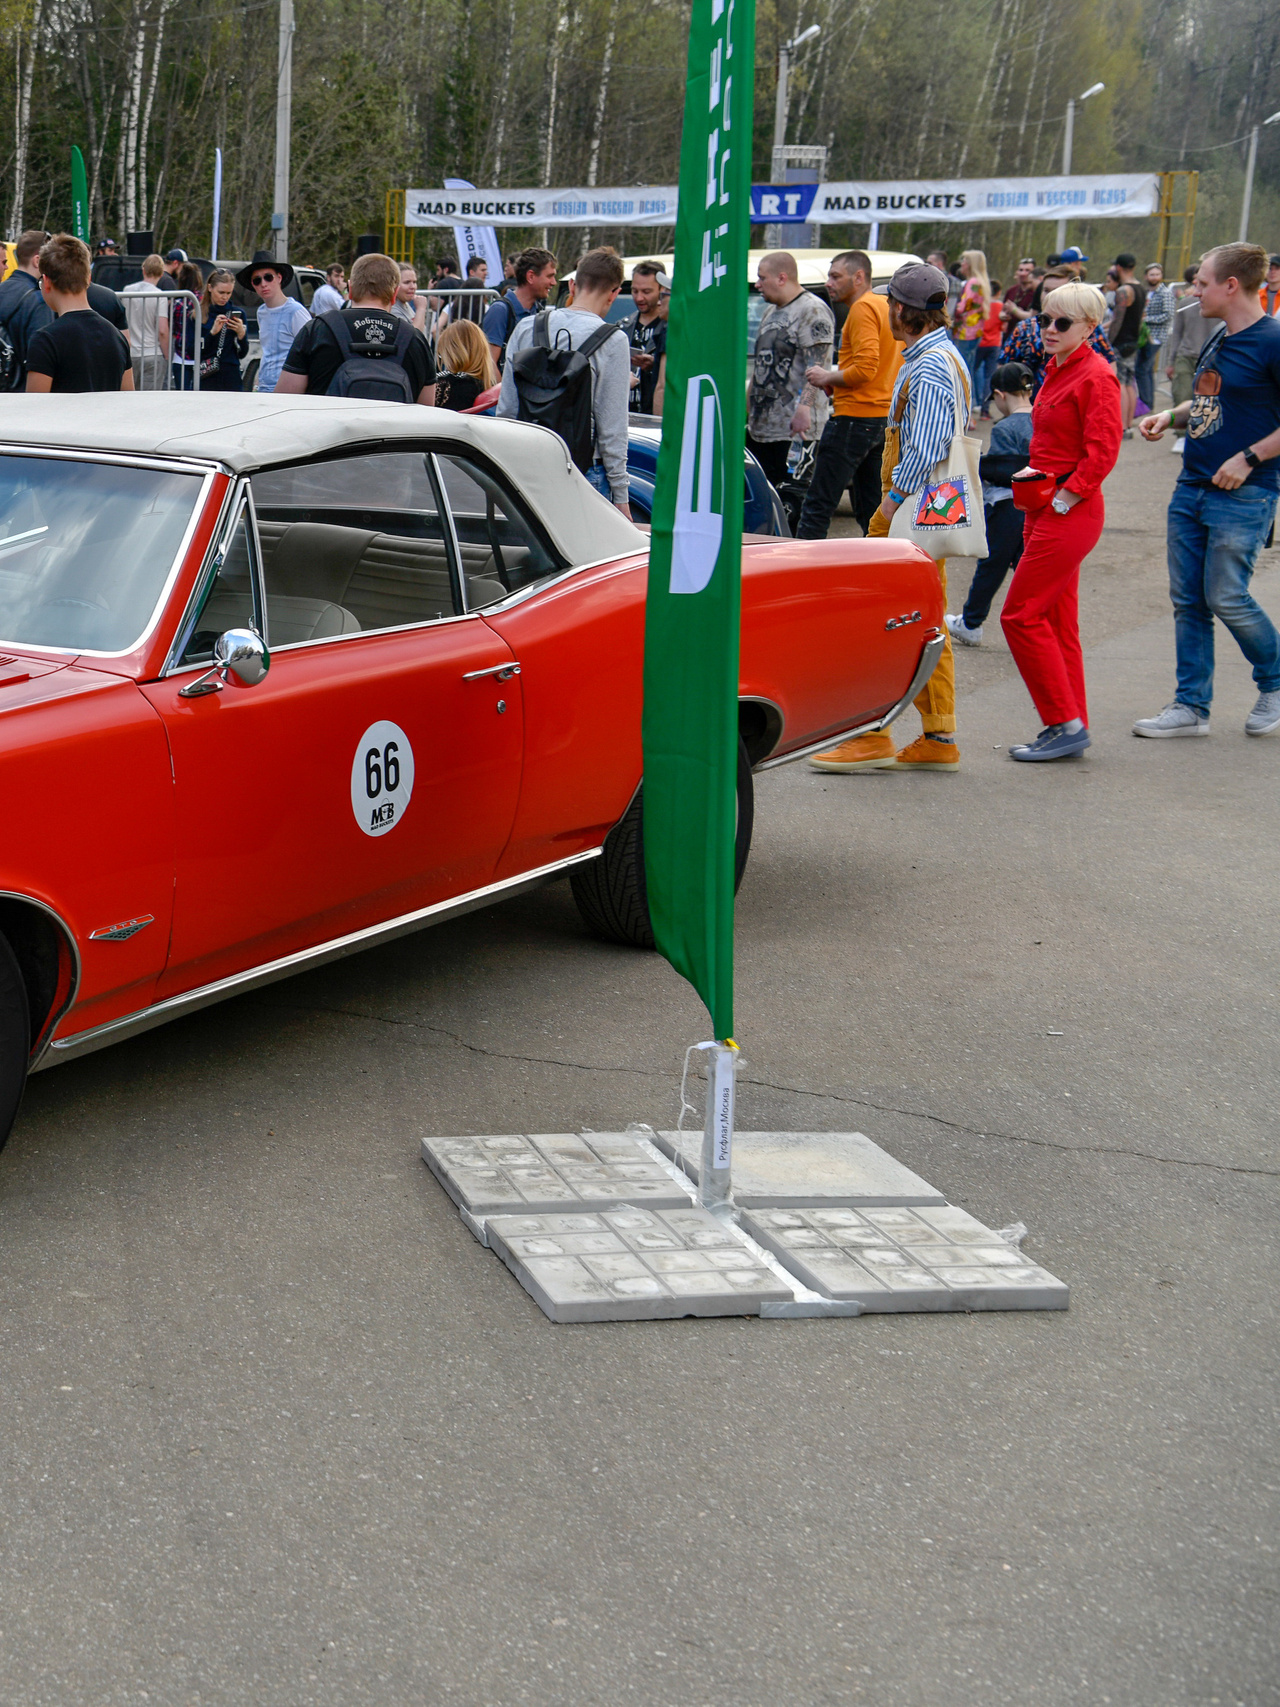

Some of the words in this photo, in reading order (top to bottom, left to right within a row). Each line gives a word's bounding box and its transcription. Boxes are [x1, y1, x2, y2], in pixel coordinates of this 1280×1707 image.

[417, 202, 456, 215] MAD
[461, 201, 535, 215] BUCKETS
[824, 196, 870, 210] MAD
[876, 193, 966, 210] BUCKETS
[365, 741, 400, 799] 66
